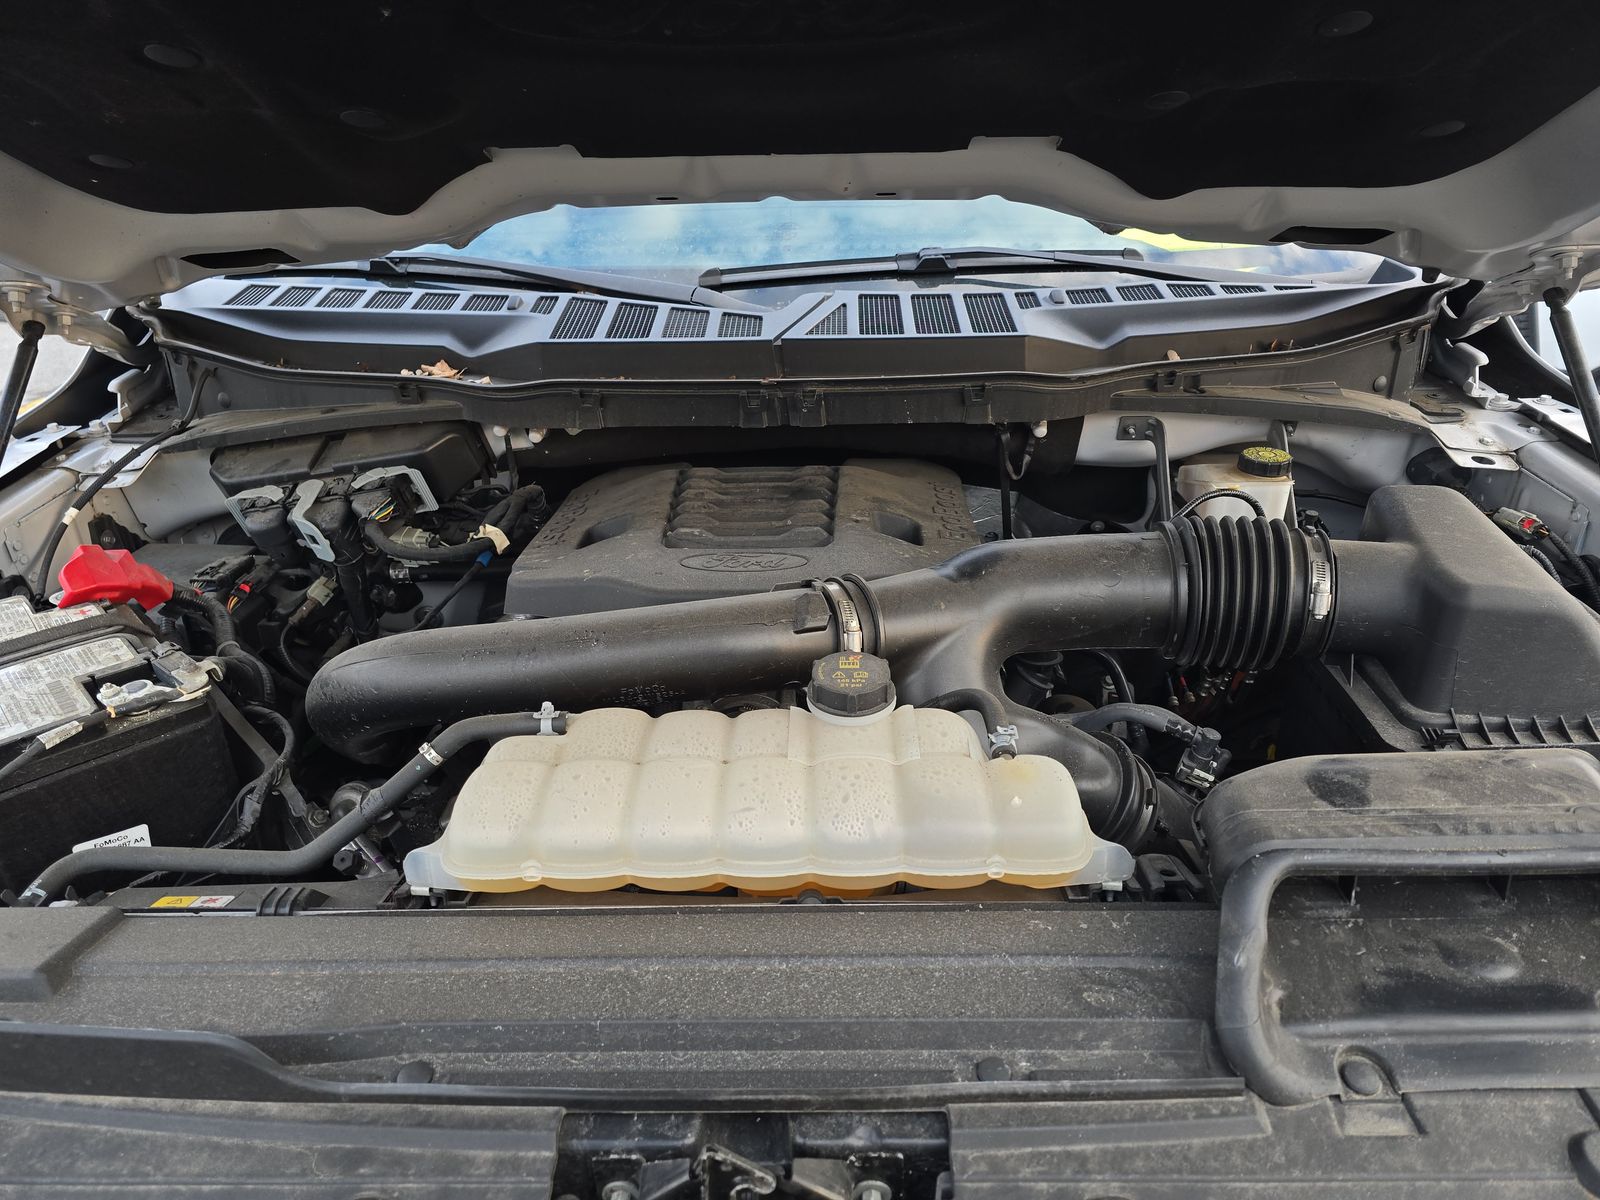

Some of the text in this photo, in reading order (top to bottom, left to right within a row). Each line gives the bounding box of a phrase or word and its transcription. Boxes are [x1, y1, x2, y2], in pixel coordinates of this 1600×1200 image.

[702, 555, 787, 568] Ford
[93, 835, 129, 849] FoMoCo
[133, 836, 145, 845] AA
